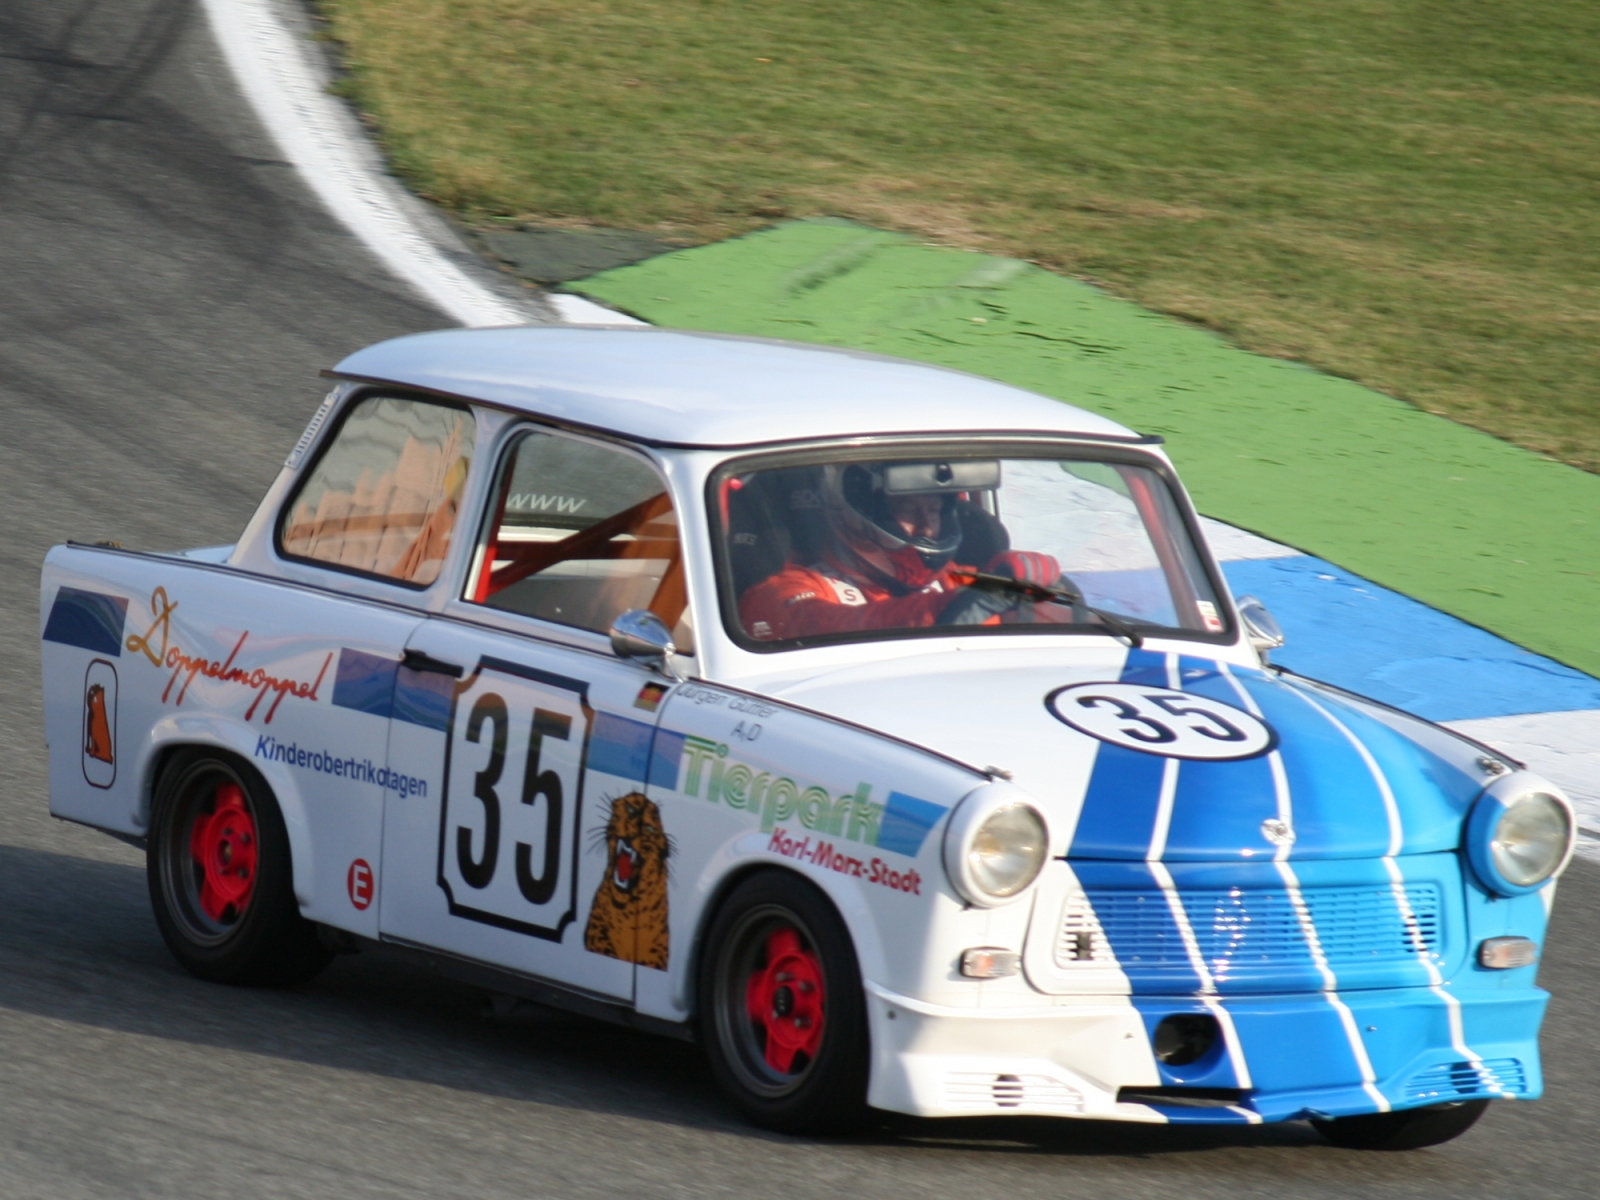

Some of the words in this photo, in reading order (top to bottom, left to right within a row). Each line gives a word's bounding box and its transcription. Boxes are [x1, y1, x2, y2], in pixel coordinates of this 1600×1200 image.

[125, 585, 334, 724] Doppelmoppel
[1075, 694, 1248, 744] 35
[254, 734, 428, 799] Kinderobertrikotagen
[457, 691, 572, 905] 35
[683, 734, 885, 846] Tierpark
[351, 863, 370, 905] E
